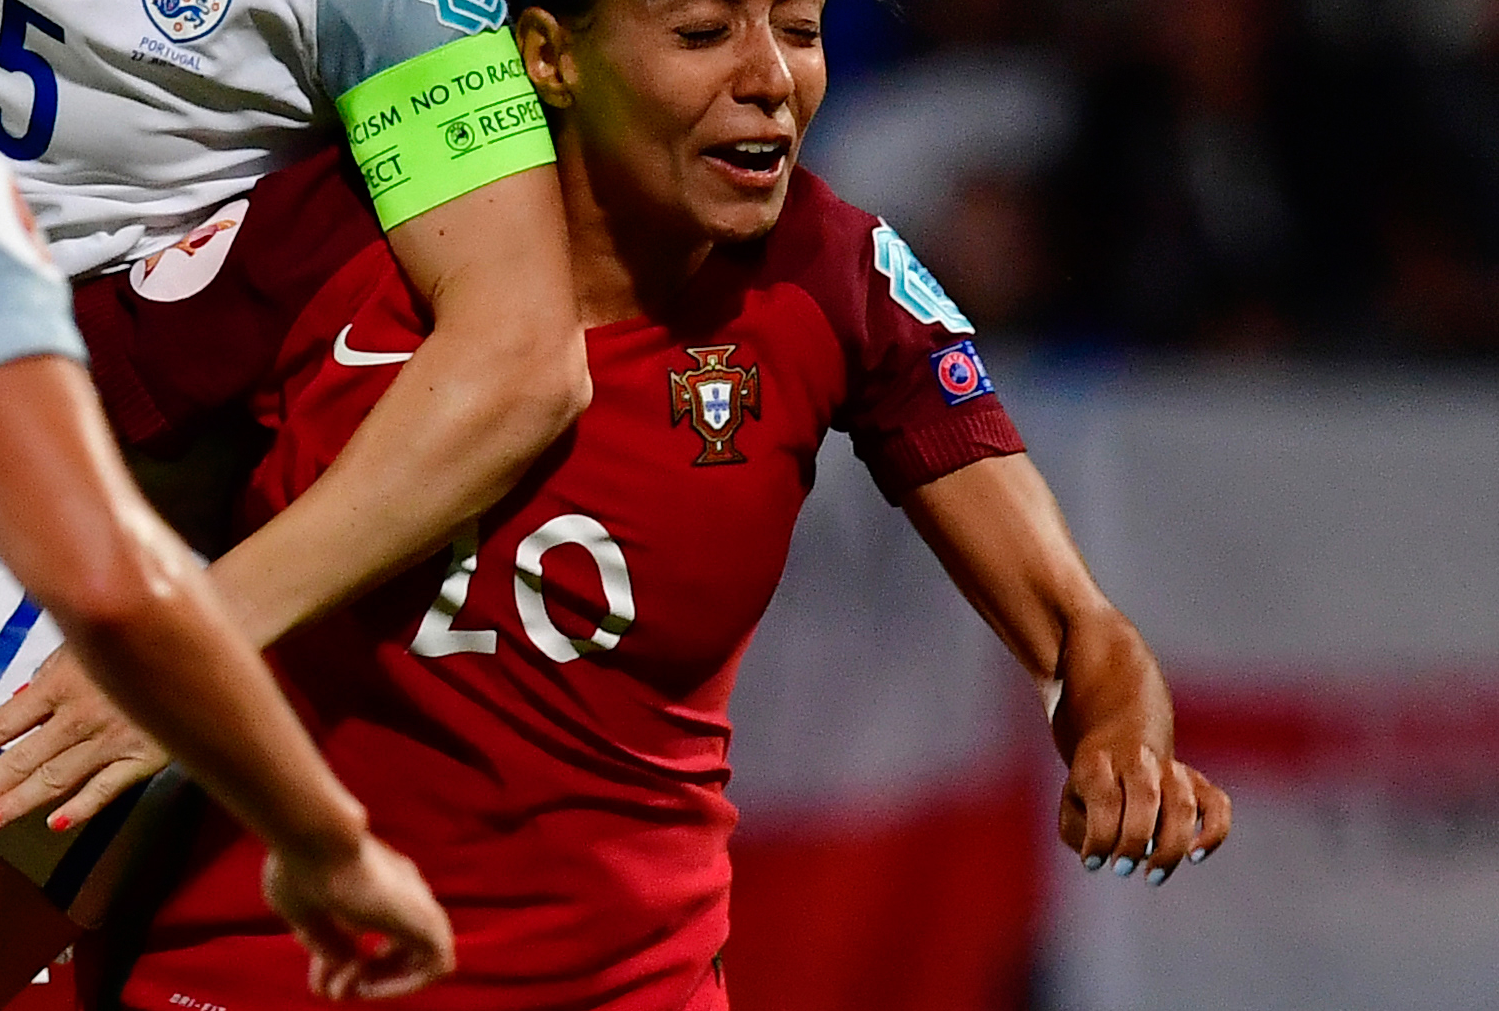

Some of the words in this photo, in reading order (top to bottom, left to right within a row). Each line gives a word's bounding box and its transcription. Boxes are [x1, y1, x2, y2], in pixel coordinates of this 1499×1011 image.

[139, 36, 202, 71] PORTUGAL
[410, 84, 450, 115] NO
[451, 71, 484, 96] TO
[365, 153, 404, 190] ECT
[405, 513, 636, 664] 20
